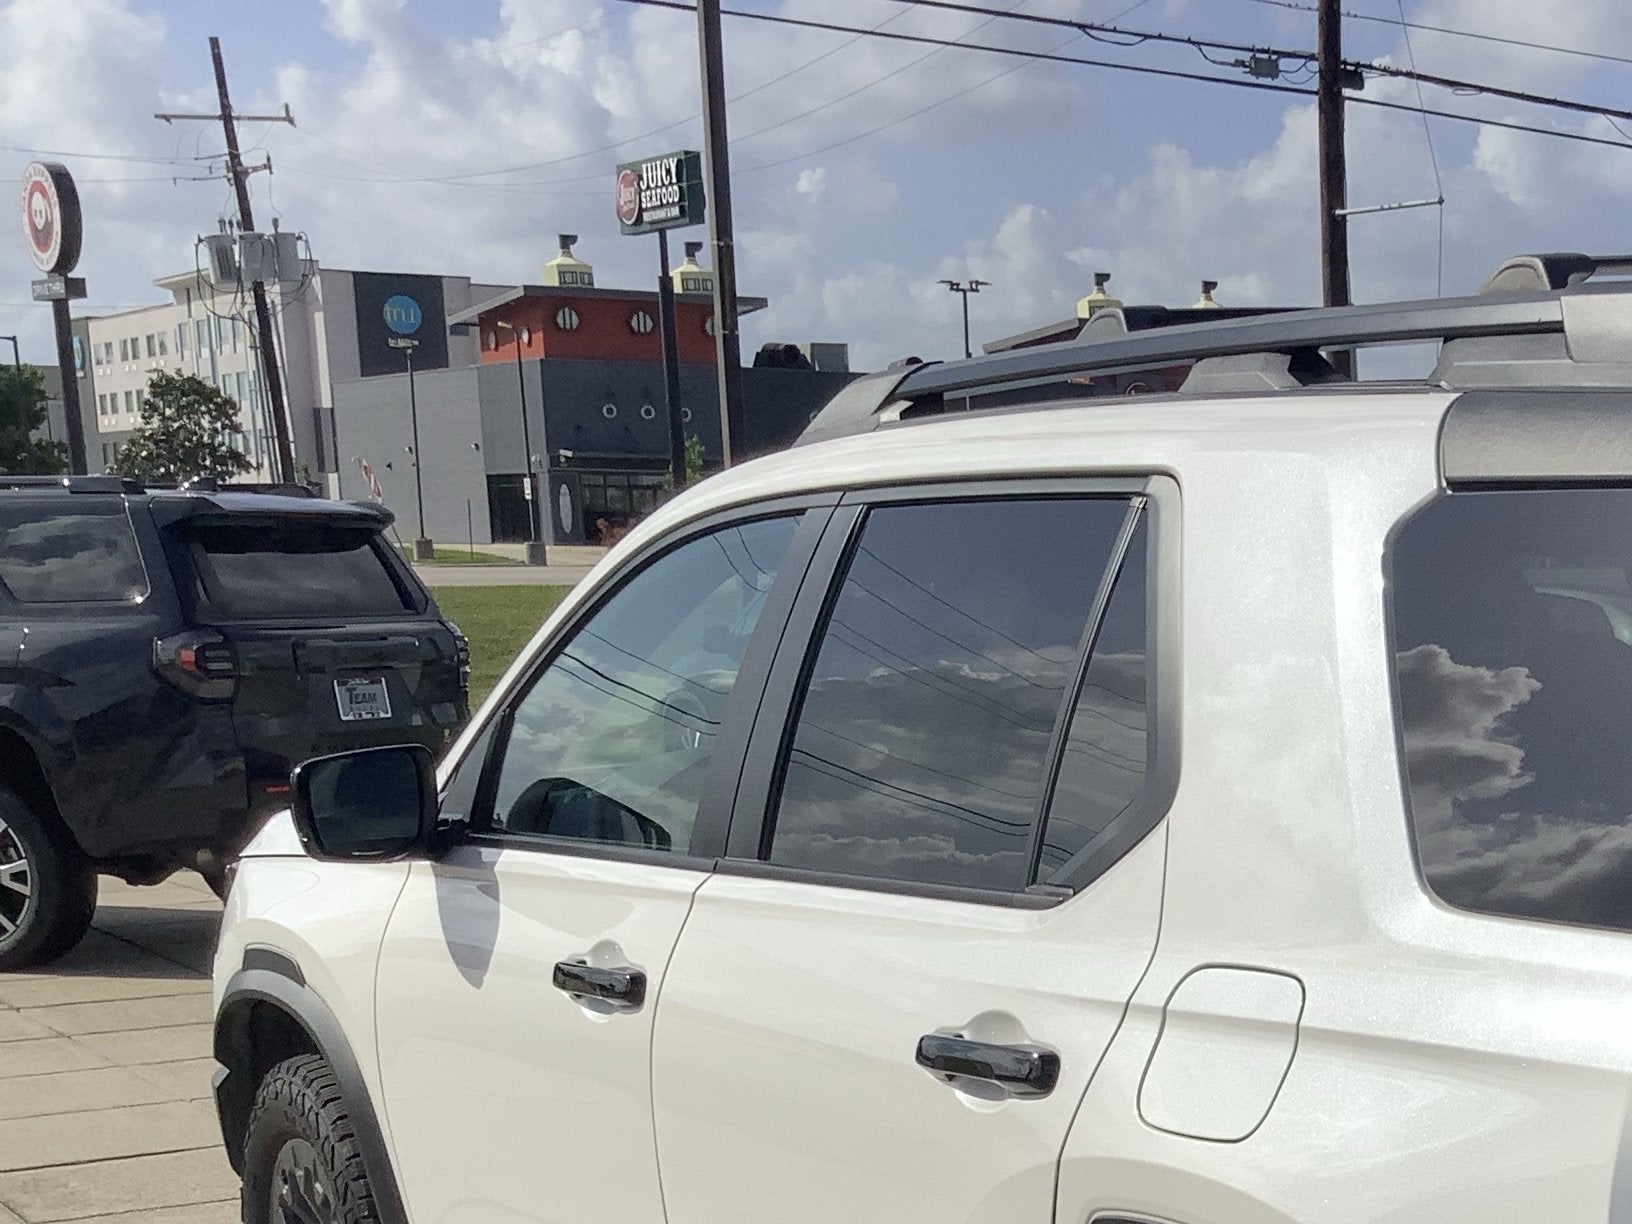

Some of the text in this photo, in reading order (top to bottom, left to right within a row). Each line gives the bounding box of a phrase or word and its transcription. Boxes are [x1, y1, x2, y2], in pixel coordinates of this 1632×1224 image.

[640, 157, 677, 190] JUICY
[640, 184, 680, 209] SEAFOOD
[383, 303, 417, 323] tru
[345, 687, 377, 705] TEAM
